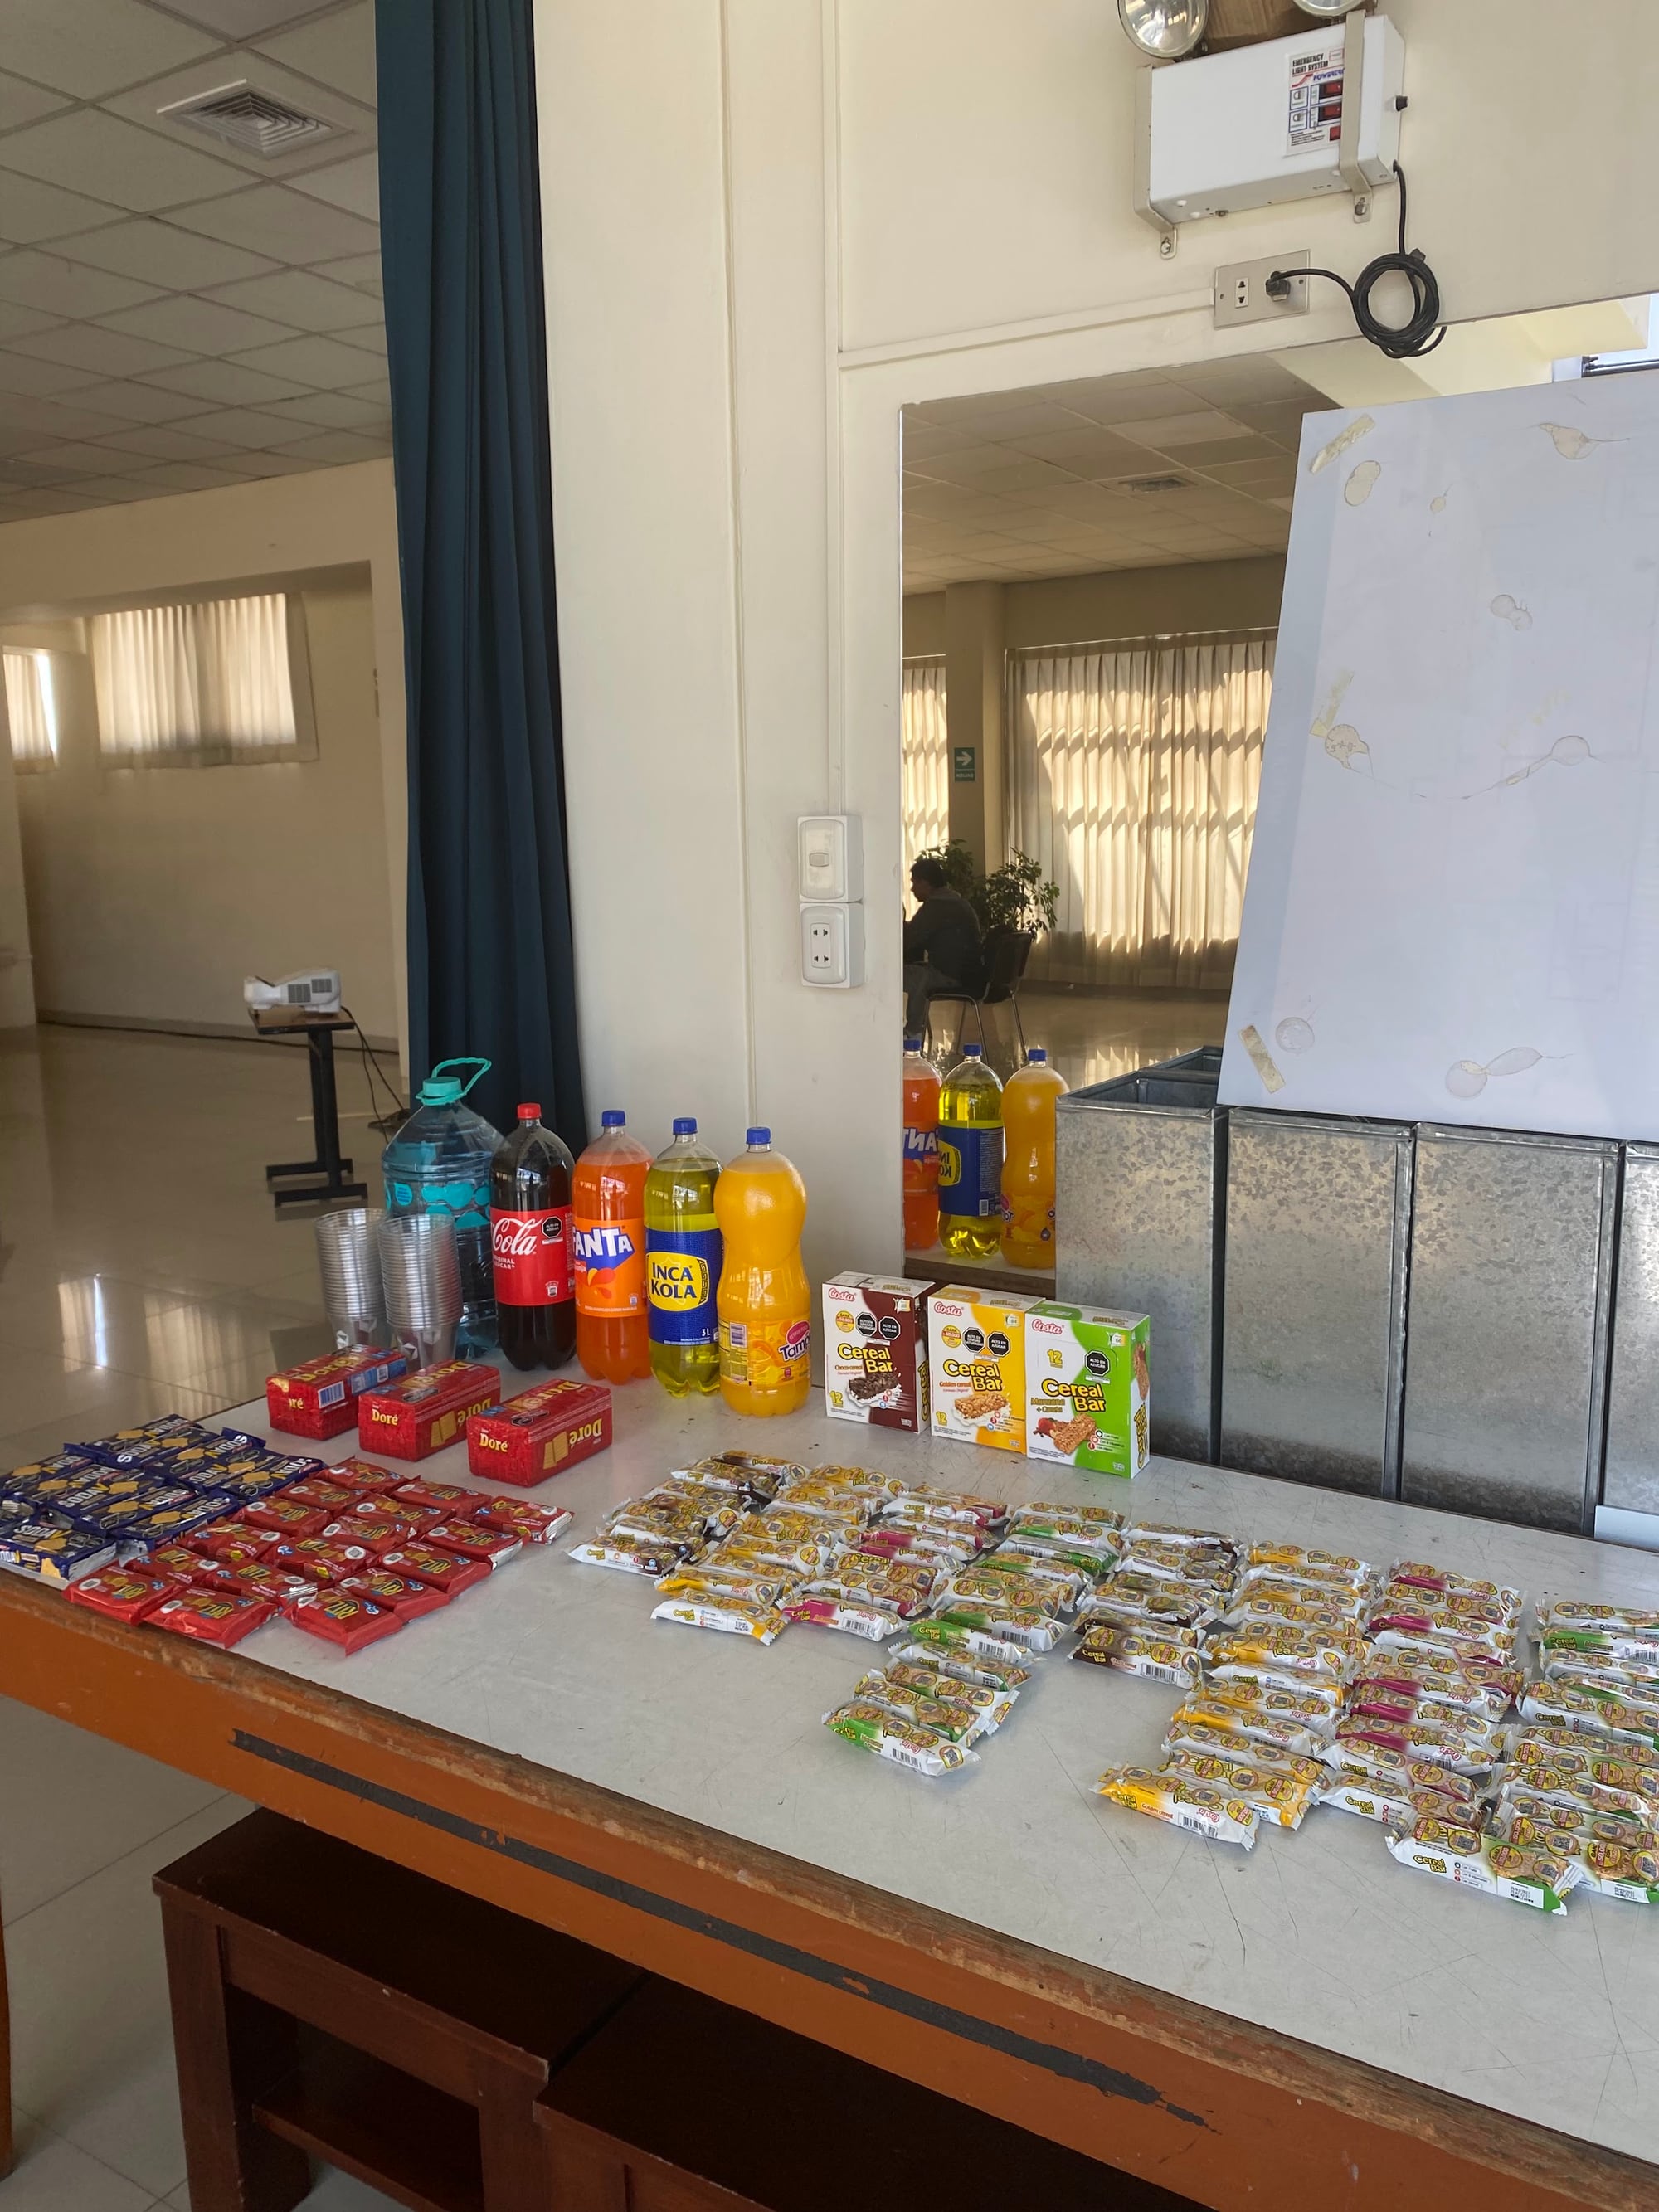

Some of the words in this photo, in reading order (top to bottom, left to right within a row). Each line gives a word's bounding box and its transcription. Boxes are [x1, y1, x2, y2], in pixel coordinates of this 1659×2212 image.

[1292, 53, 1324, 67] EMERGENCY
[1292, 66, 1306, 75] LIGHT
[1307, 60, 1329, 71] SYSTEM
[652, 1262, 694, 1281] INCA
[650, 1278, 697, 1300] KOLA
[829, 1287, 855, 1302] Costa
[934, 1301, 962, 1316] Costa
[1032, 1319, 1062, 1334] Costa
[838, 1343, 891, 1360] Cereal
[1047, 1349, 1063, 1364] 12
[864, 1359, 893, 1373] Bar
[943, 1359, 1000, 1378] Cereal
[972, 1376, 1003, 1392] Bar
[1041, 1378, 1104, 1398] Cereal
[830, 1391, 843, 1403] 12
[1073, 1396, 1107, 1412] Bar
[372, 1407, 398, 1425] Doré
[936, 1411, 947, 1423] 12
[569, 1418, 602, 1449] Doré
[479, 1432, 508, 1452] Doré
[1141, 1803, 1159, 1813] Golden
[1345, 1796, 1374, 1808] Cereal
[1413, 1855, 1445, 1866] Cereal
